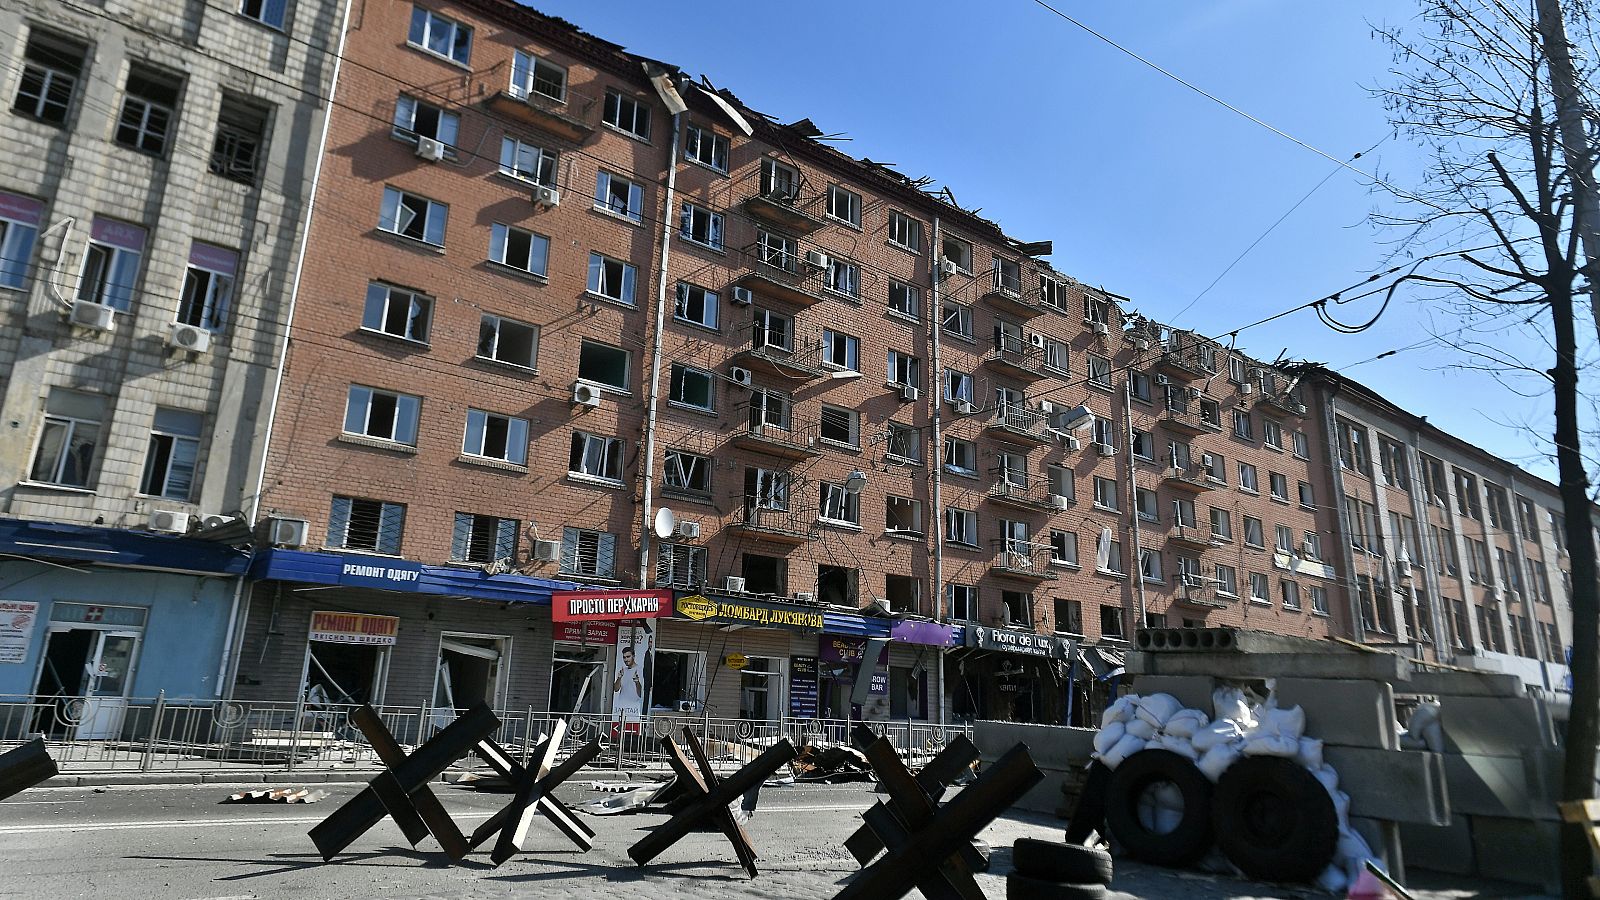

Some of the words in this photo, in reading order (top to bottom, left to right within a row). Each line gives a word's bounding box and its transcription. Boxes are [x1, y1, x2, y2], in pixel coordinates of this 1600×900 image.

[343, 564, 386, 579] РЕМОНТ
[387, 568, 419, 581] ОДЯГУ
[570, 598, 605, 615] ПРОСТО
[719, 603, 769, 624] ЛОМБАРД
[314, 613, 358, 632] РЕМОНТ
[361, 617, 396, 636] ОДЯГУ
[314, 633, 345, 642] ЯКІСНО
[358, 636, 393, 645] ШВИДКО
[992, 630, 1015, 644] Flora
[1019, 634, 1031, 646] de
[871, 683, 884, 692] BAR
[872, 675, 887, 684] ROW
